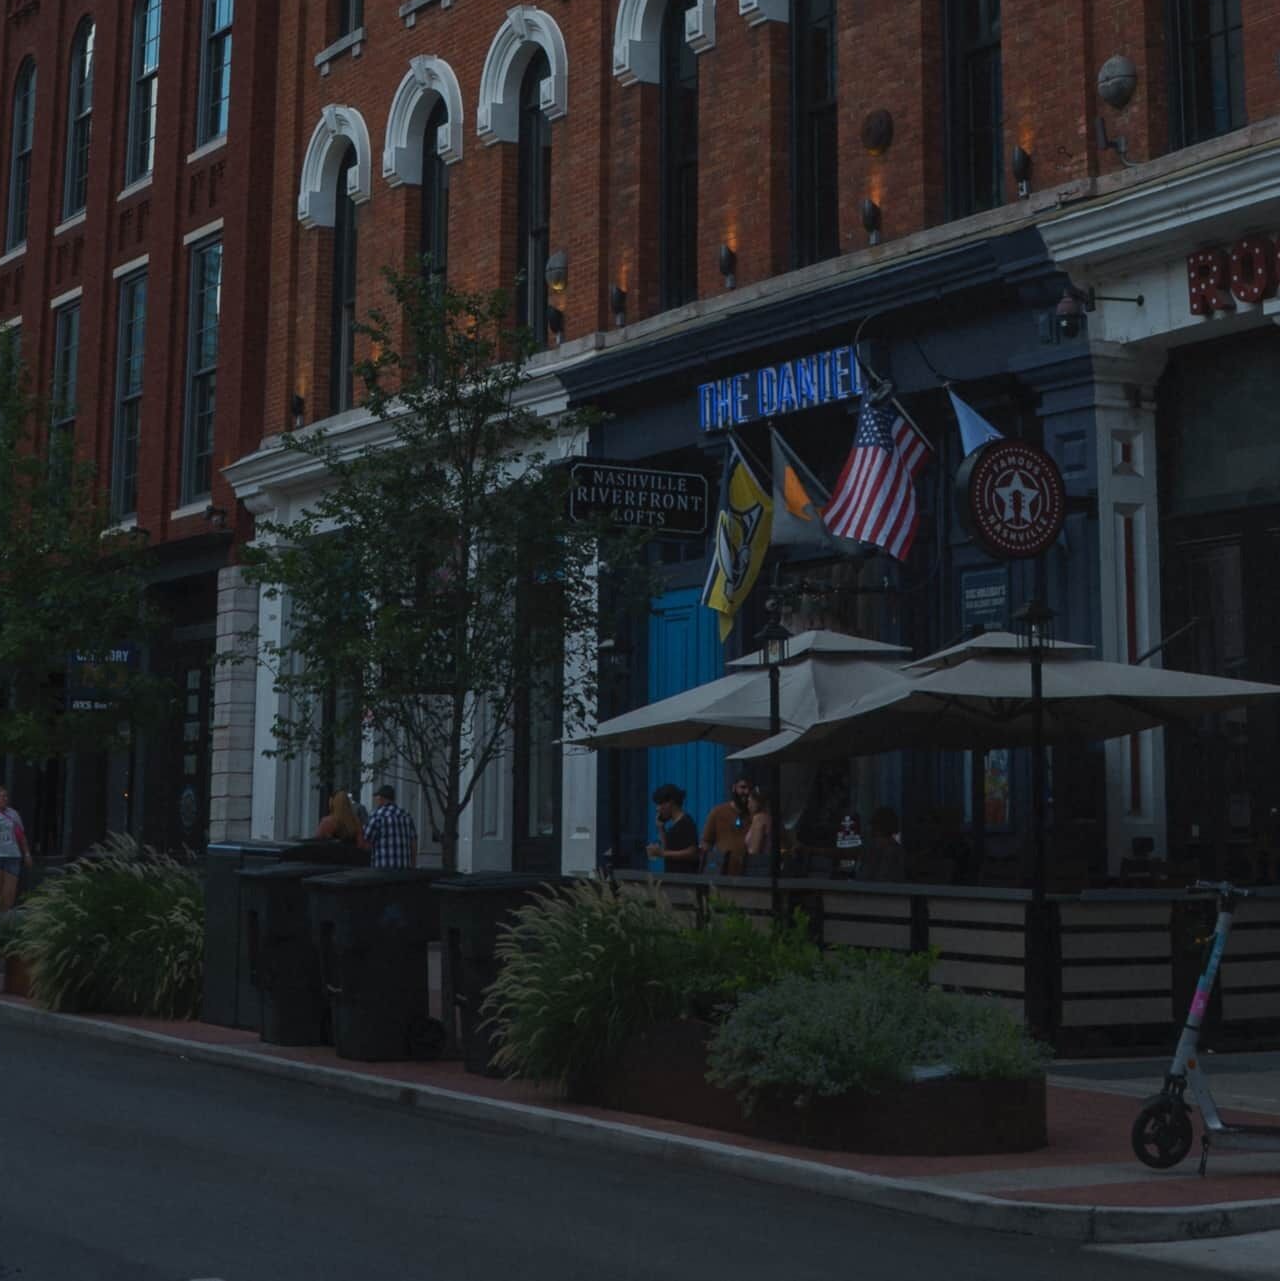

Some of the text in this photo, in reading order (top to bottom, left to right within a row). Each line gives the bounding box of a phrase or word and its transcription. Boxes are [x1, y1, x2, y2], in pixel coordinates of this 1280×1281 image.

[697, 372, 750, 432] THE
[993, 456, 1041, 475] FAMOUS
[593, 470, 688, 493] NASHVILLE
[577, 487, 704, 512] RIVERFRONT
